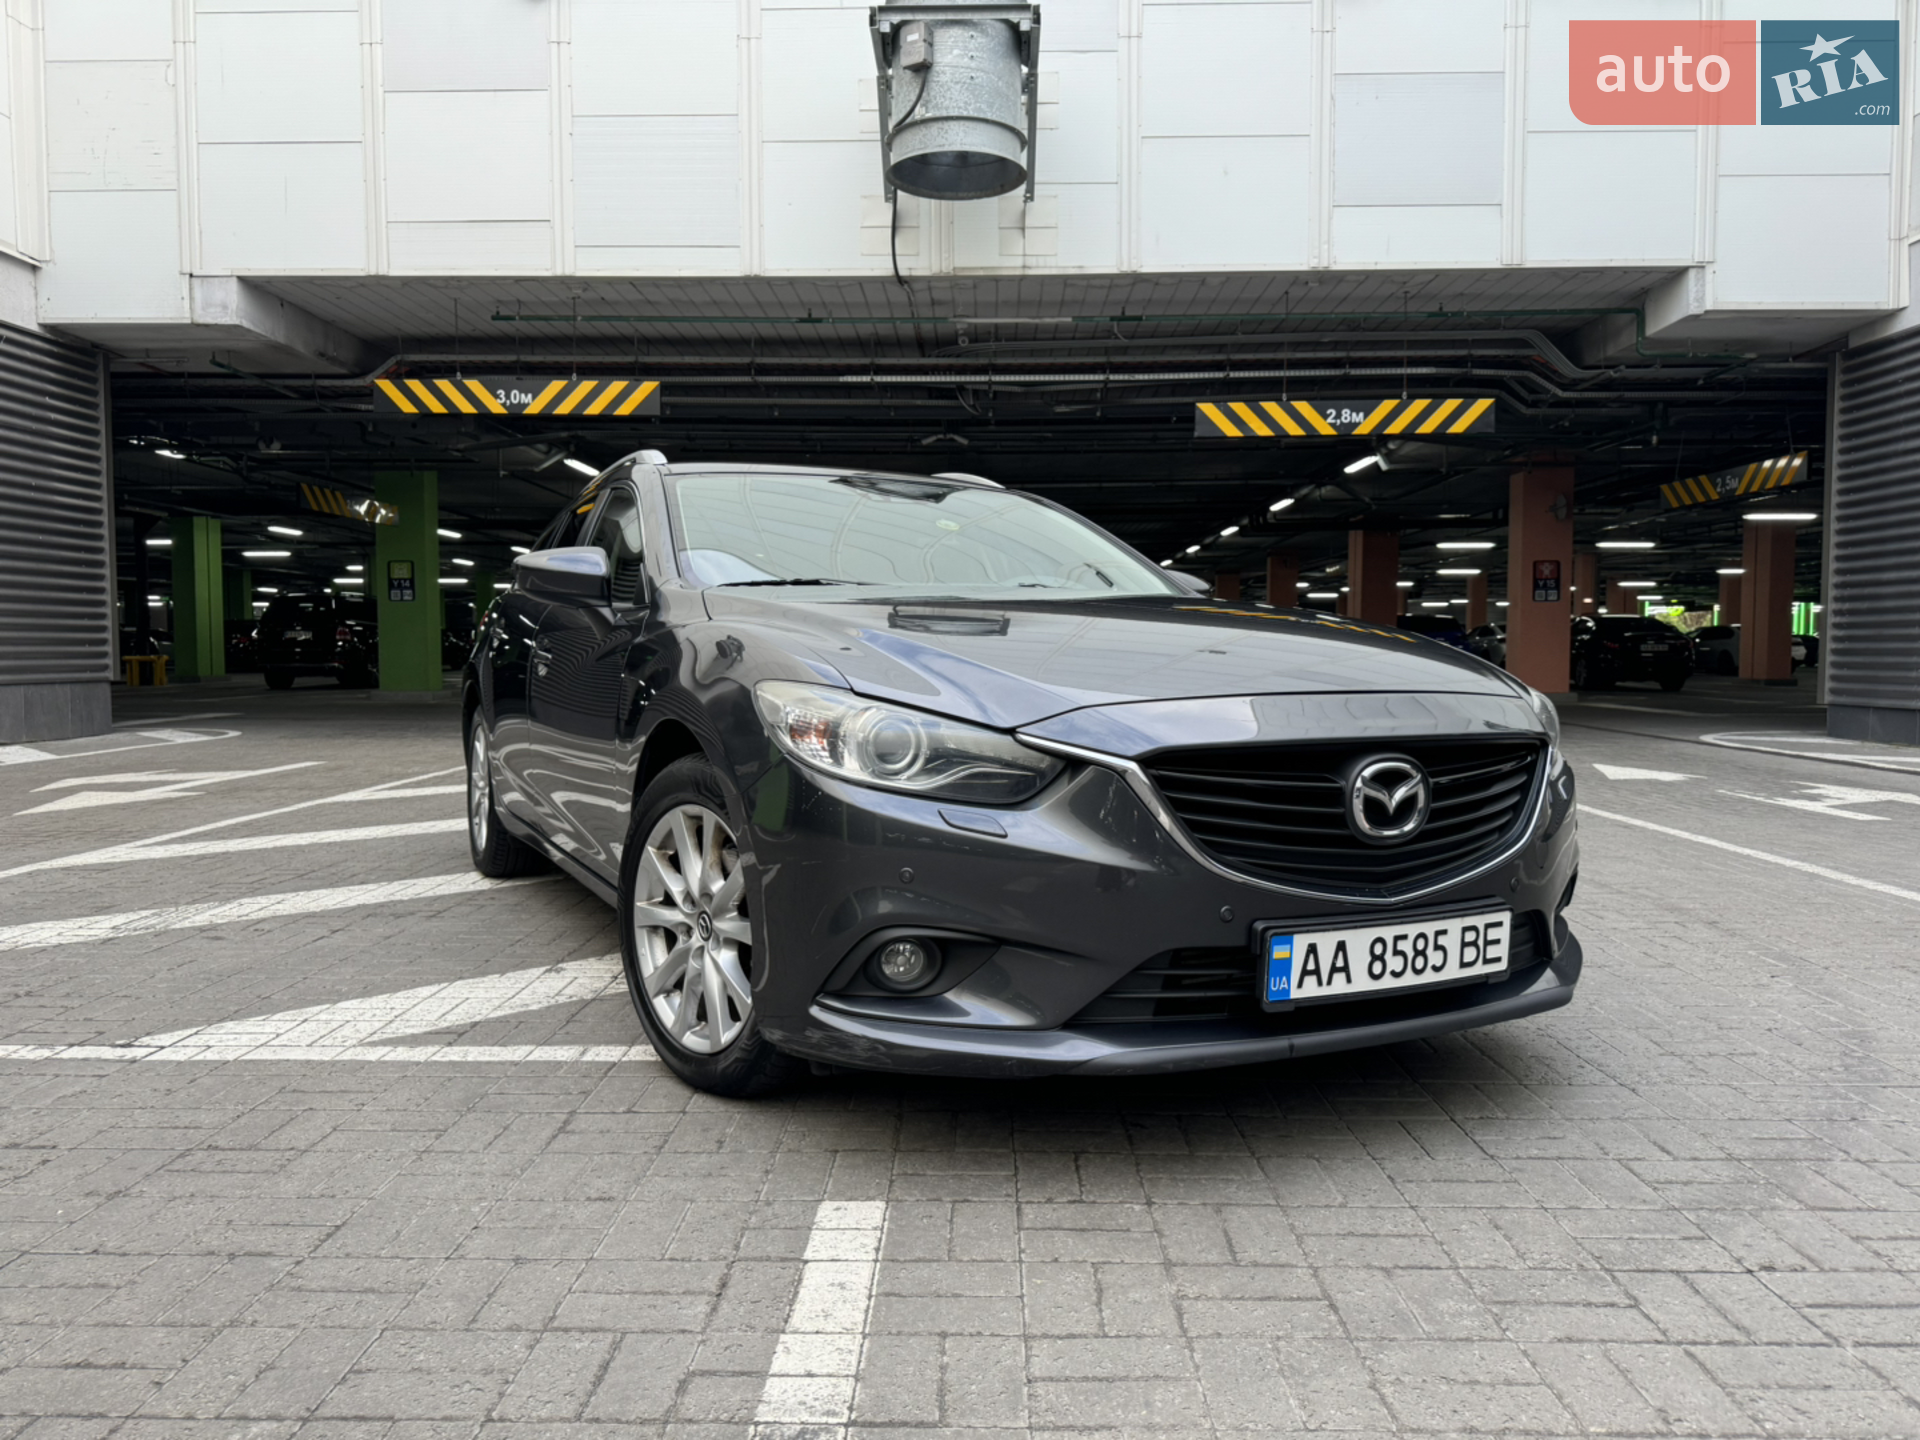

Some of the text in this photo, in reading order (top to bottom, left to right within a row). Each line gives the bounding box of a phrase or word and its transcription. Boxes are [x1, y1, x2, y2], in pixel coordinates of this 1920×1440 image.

[496, 389, 533, 406] 3,0м
[1326, 409, 1364, 426] 2,8м
[1297, 920, 1504, 989] AA 8585 BE
[1270, 976, 1289, 991] UA
